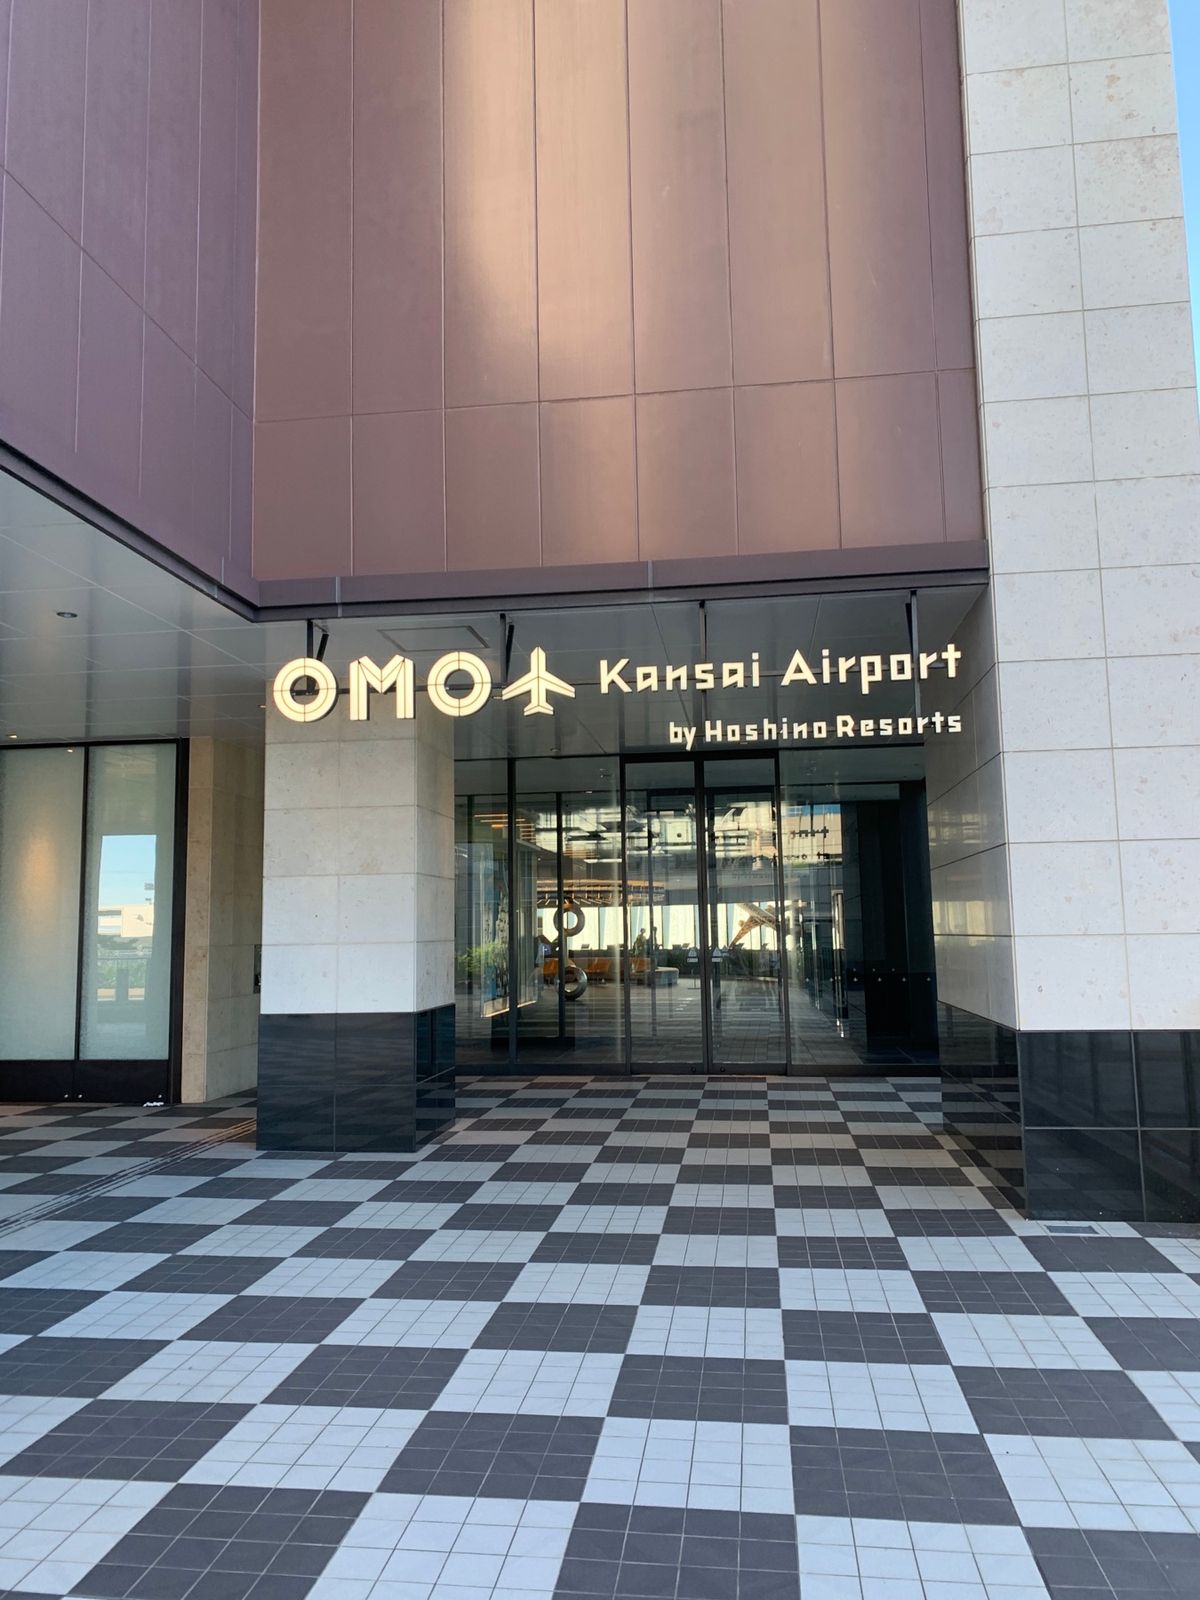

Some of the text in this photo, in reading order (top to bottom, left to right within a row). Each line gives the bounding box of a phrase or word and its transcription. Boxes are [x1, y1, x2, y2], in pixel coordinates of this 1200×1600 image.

[272, 643, 962, 723] OMO Kansai Airport
[669, 711, 963, 750] by Hoshino Resorts
